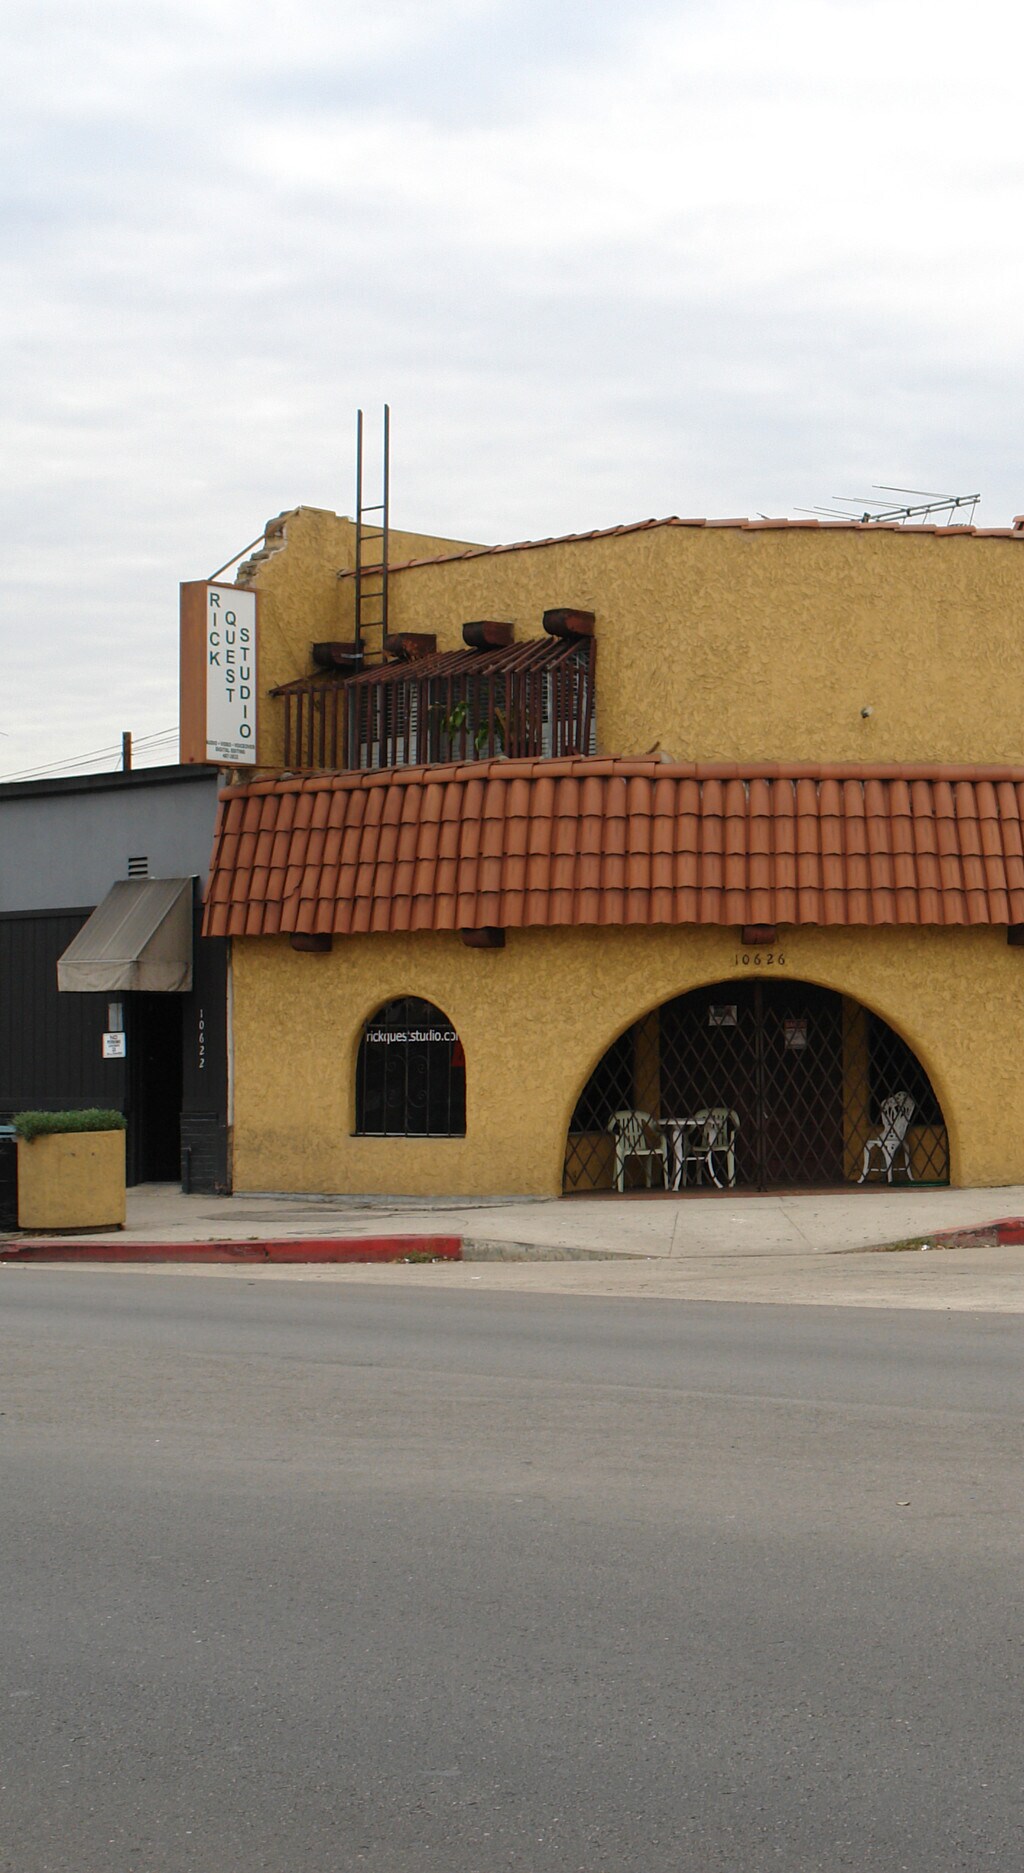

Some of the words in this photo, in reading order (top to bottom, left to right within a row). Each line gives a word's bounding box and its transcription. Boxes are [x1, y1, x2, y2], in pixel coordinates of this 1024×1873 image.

[209, 592, 220, 666] RICK
[225, 611, 236, 703] QUEST
[239, 628, 251, 739] STUDIO
[734, 953, 785, 966] 10626
